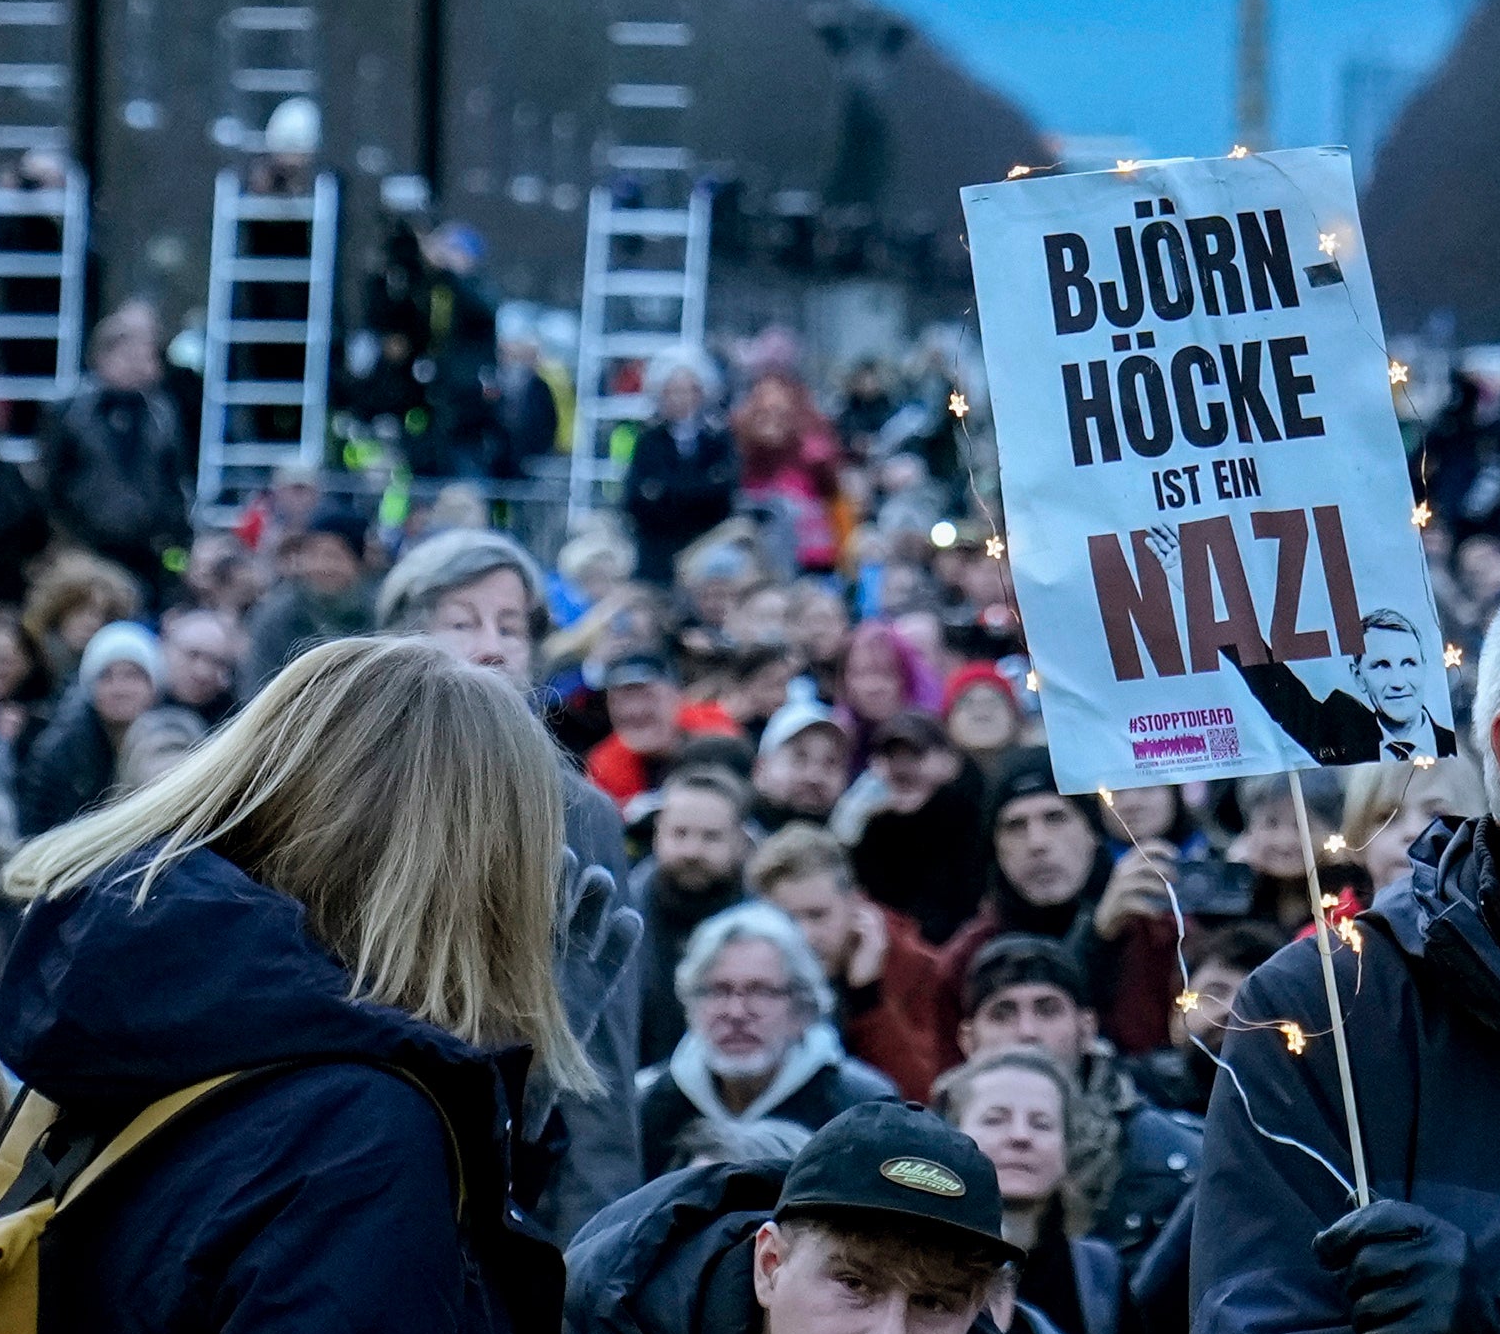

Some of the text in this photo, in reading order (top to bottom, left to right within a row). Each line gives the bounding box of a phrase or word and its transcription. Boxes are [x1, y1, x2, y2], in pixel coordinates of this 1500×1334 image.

[1043, 198, 1344, 335] BJÖRN-
[1061, 331, 1326, 466] HÖCKE
[1151, 457, 1262, 511] IST EIN
[1087, 505, 1366, 682] NAZI
[1129, 708, 1234, 734] #STOPPTDIEAFD
[889, 1161, 962, 1191] Billabong
